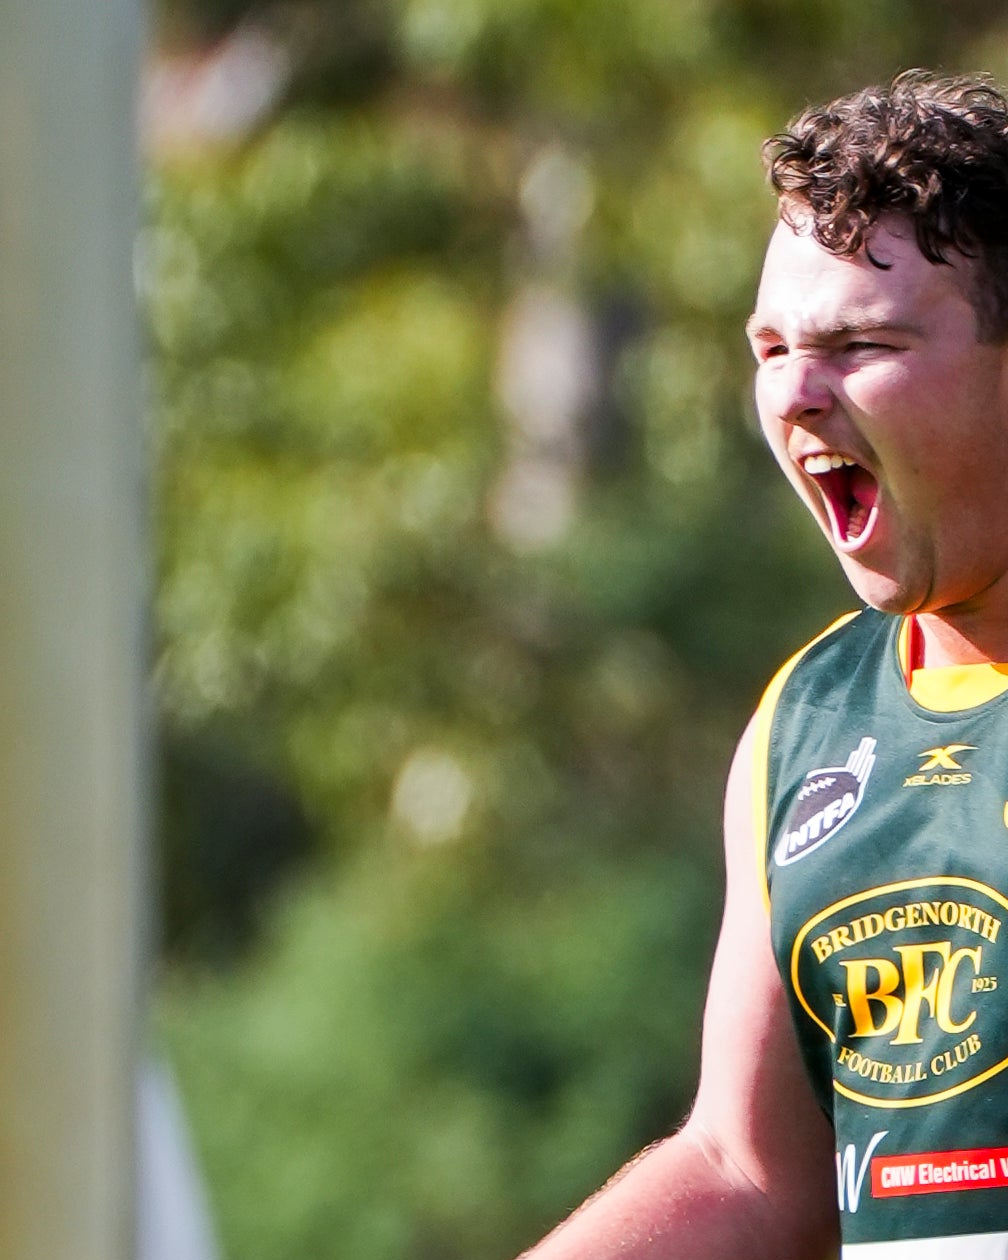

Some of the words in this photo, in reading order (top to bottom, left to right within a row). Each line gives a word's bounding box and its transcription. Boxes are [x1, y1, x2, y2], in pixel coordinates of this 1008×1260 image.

[903, 773, 972, 787] XBLADES
[788, 793, 855, 852] NTFA
[811, 902, 1001, 963] BRIDGENORTH
[839, 942, 982, 1046] BFC
[837, 1047, 927, 1084] FOOTBALL
[931, 1035, 982, 1076] CLUB
[881, 1164, 915, 1188] CNW
[919, 1158, 996, 1184] Electrical
